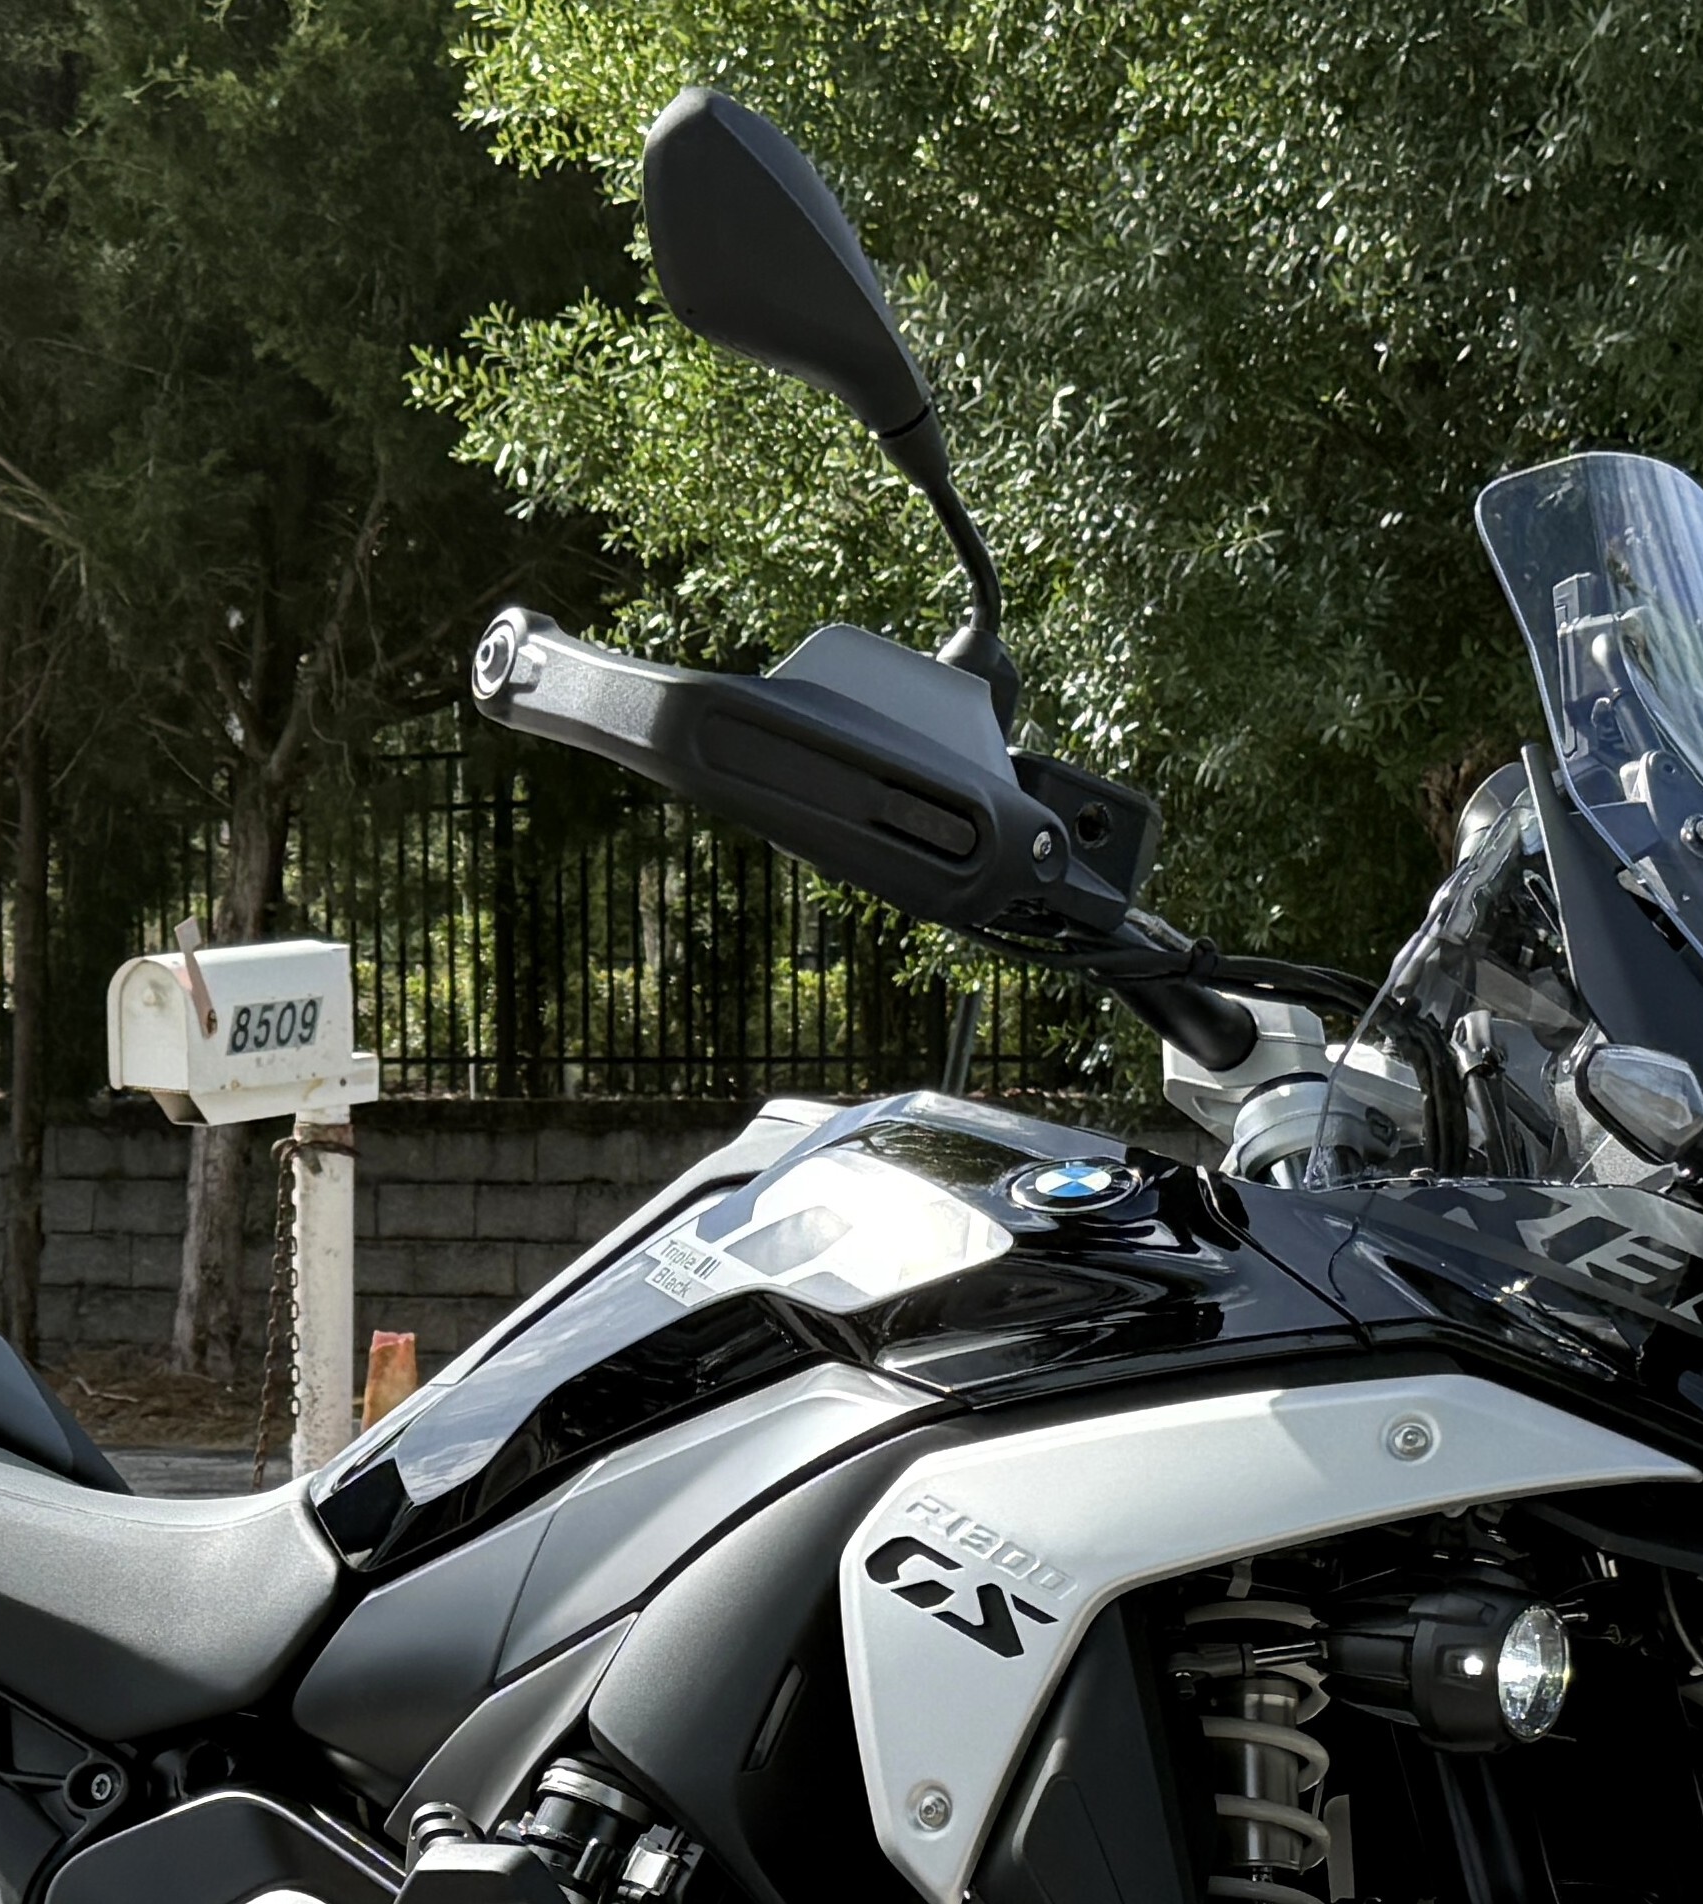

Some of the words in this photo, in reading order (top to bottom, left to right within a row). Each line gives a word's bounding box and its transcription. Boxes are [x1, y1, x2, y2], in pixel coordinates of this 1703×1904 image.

[229, 998, 318, 1054] 8509
[651, 1266, 692, 1299] Black
[660, 1239, 697, 1271] Triple
[904, 1494, 1079, 1600] R1300
[864, 1535, 1060, 1660] GS
